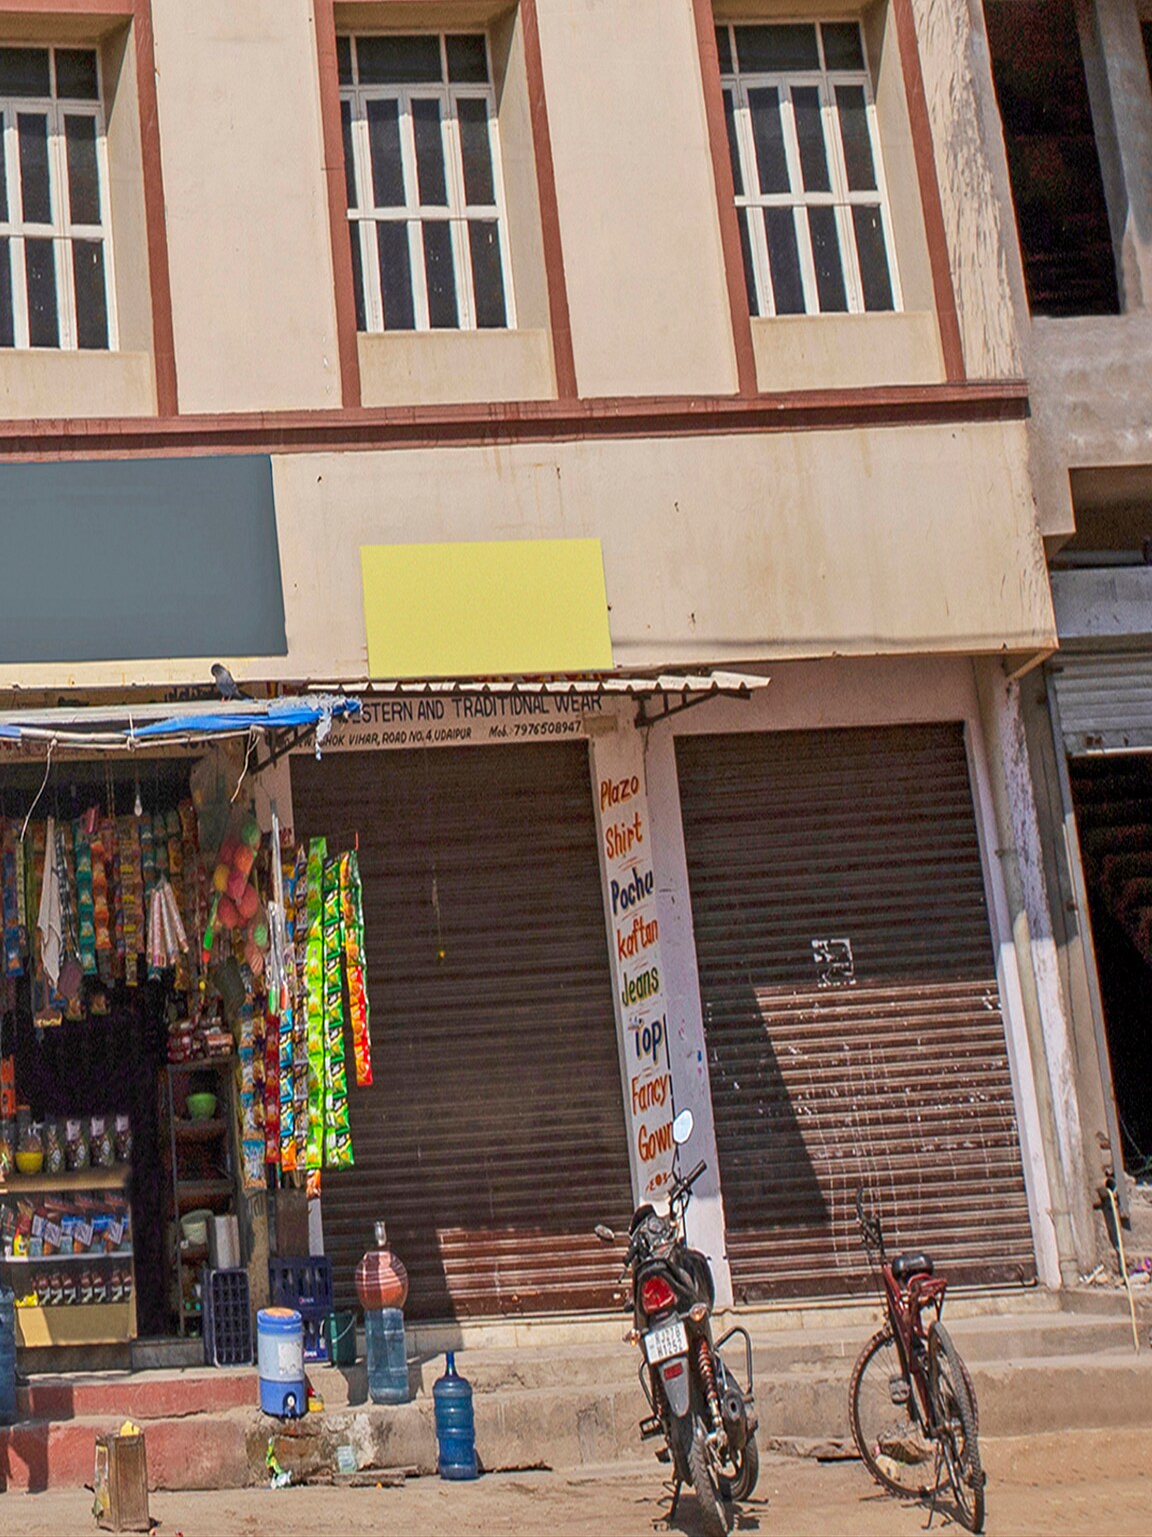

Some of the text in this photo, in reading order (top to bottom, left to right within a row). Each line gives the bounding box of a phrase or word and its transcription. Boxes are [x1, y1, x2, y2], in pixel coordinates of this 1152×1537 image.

[338, 699, 413, 724] STERN
[417, 698, 445, 720] AND
[553, 693, 602, 713] WEAR
[348, 731, 381, 747] VIHAR,
[381, 730, 408, 744] ROAD
[599, 775, 640, 813] Plazo
[605, 811, 644, 859] Shirt
[621, 966, 660, 1006] Jeans
[631, 1074, 668, 1116] Fancy
